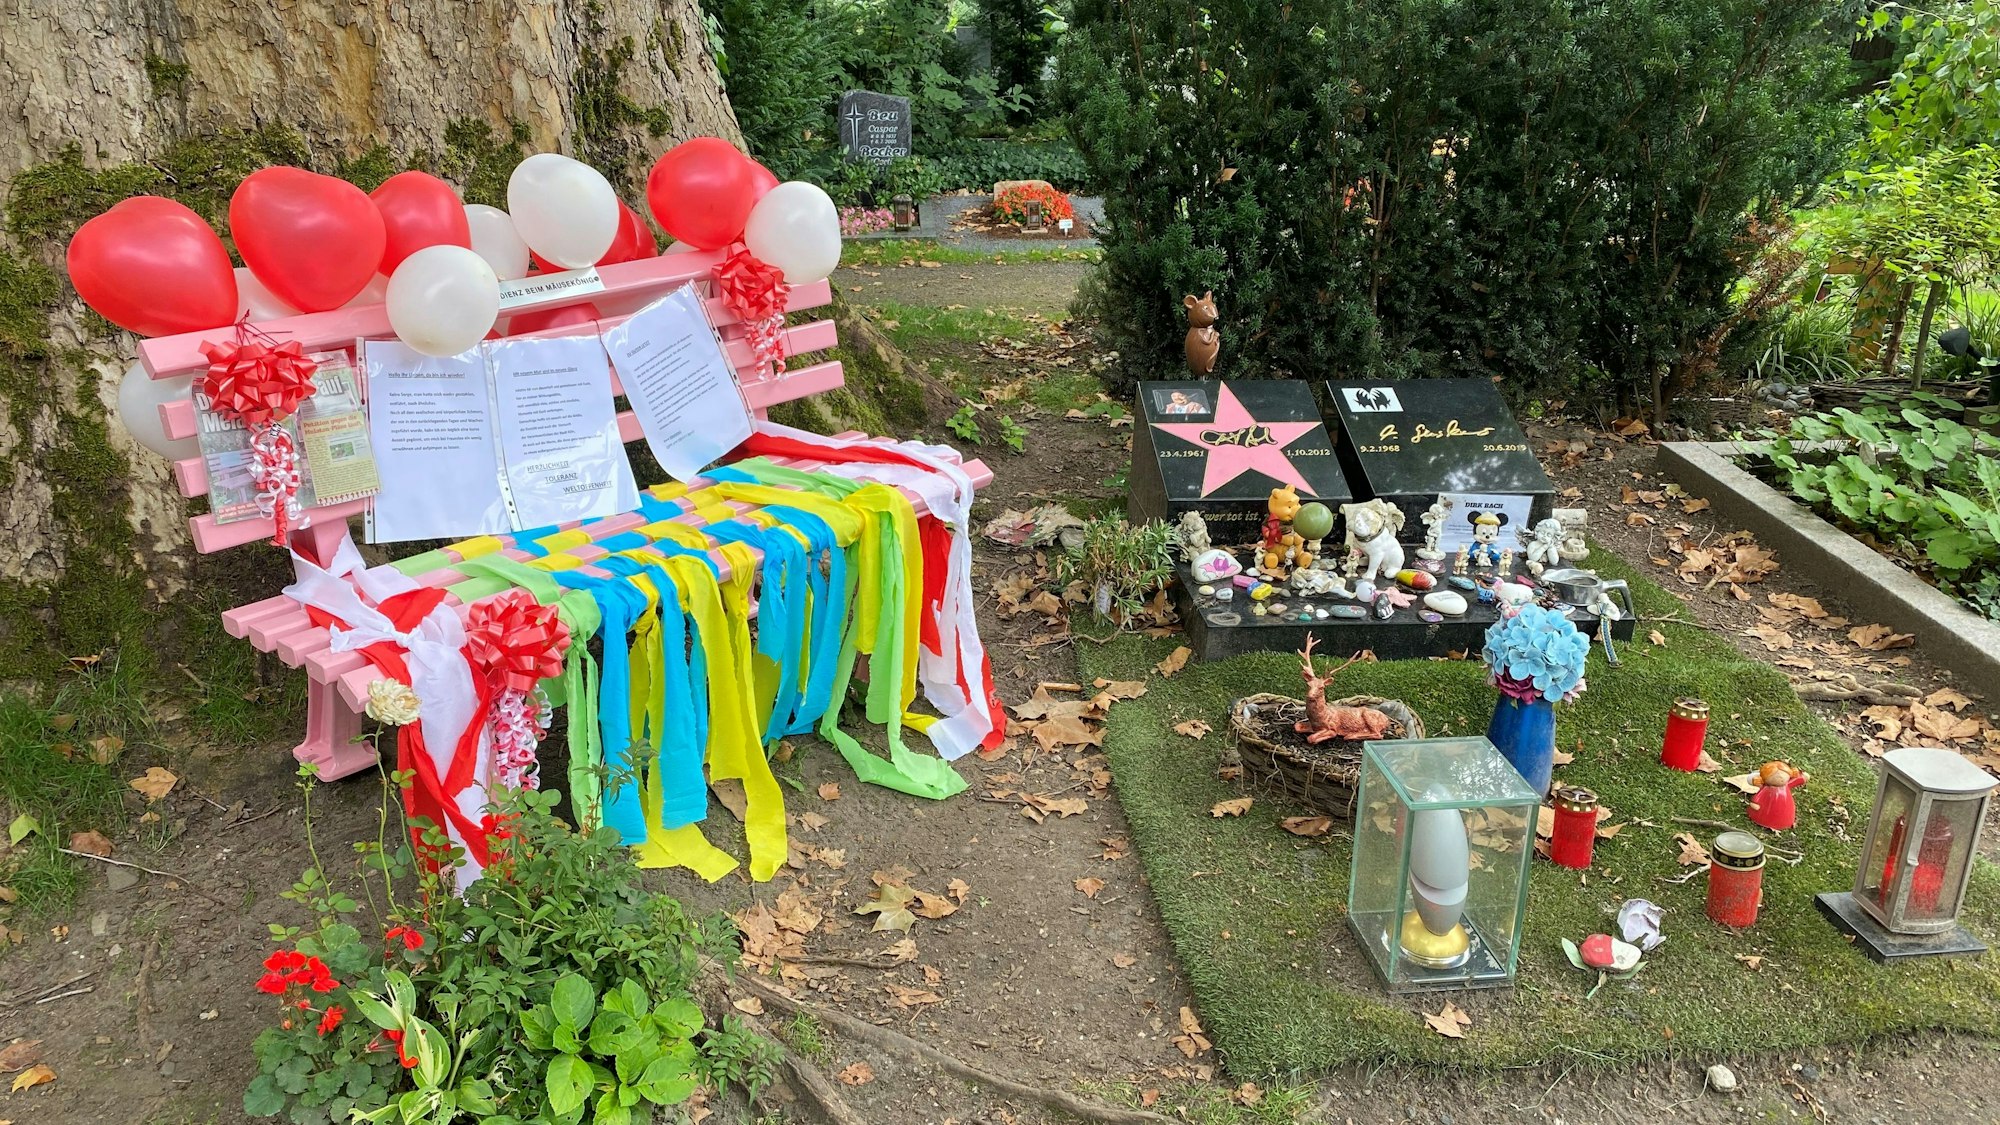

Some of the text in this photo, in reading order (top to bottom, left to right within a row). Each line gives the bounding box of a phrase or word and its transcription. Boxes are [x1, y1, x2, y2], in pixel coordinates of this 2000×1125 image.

[867, 109, 898, 122] Beu
[868, 125, 898, 133] Caspar
[860, 145, 907, 157] Becker
[500, 276, 594, 300] DIENZ BEIM MÄUSEKÖNIG
[1360, 445, 1400, 453] 9.2.1968
[1483, 444, 1527, 452] 20.6.2019
[1160, 450, 1204, 458] 23.4.1961
[527, 461, 569, 472] HERZLICHKEIT
[545, 473, 578, 482] TOLERANZ
[1204, 512, 1225, 522] wer
[1227, 511, 1243, 521] tot
[1245, 511, 1261, 522] ist,
